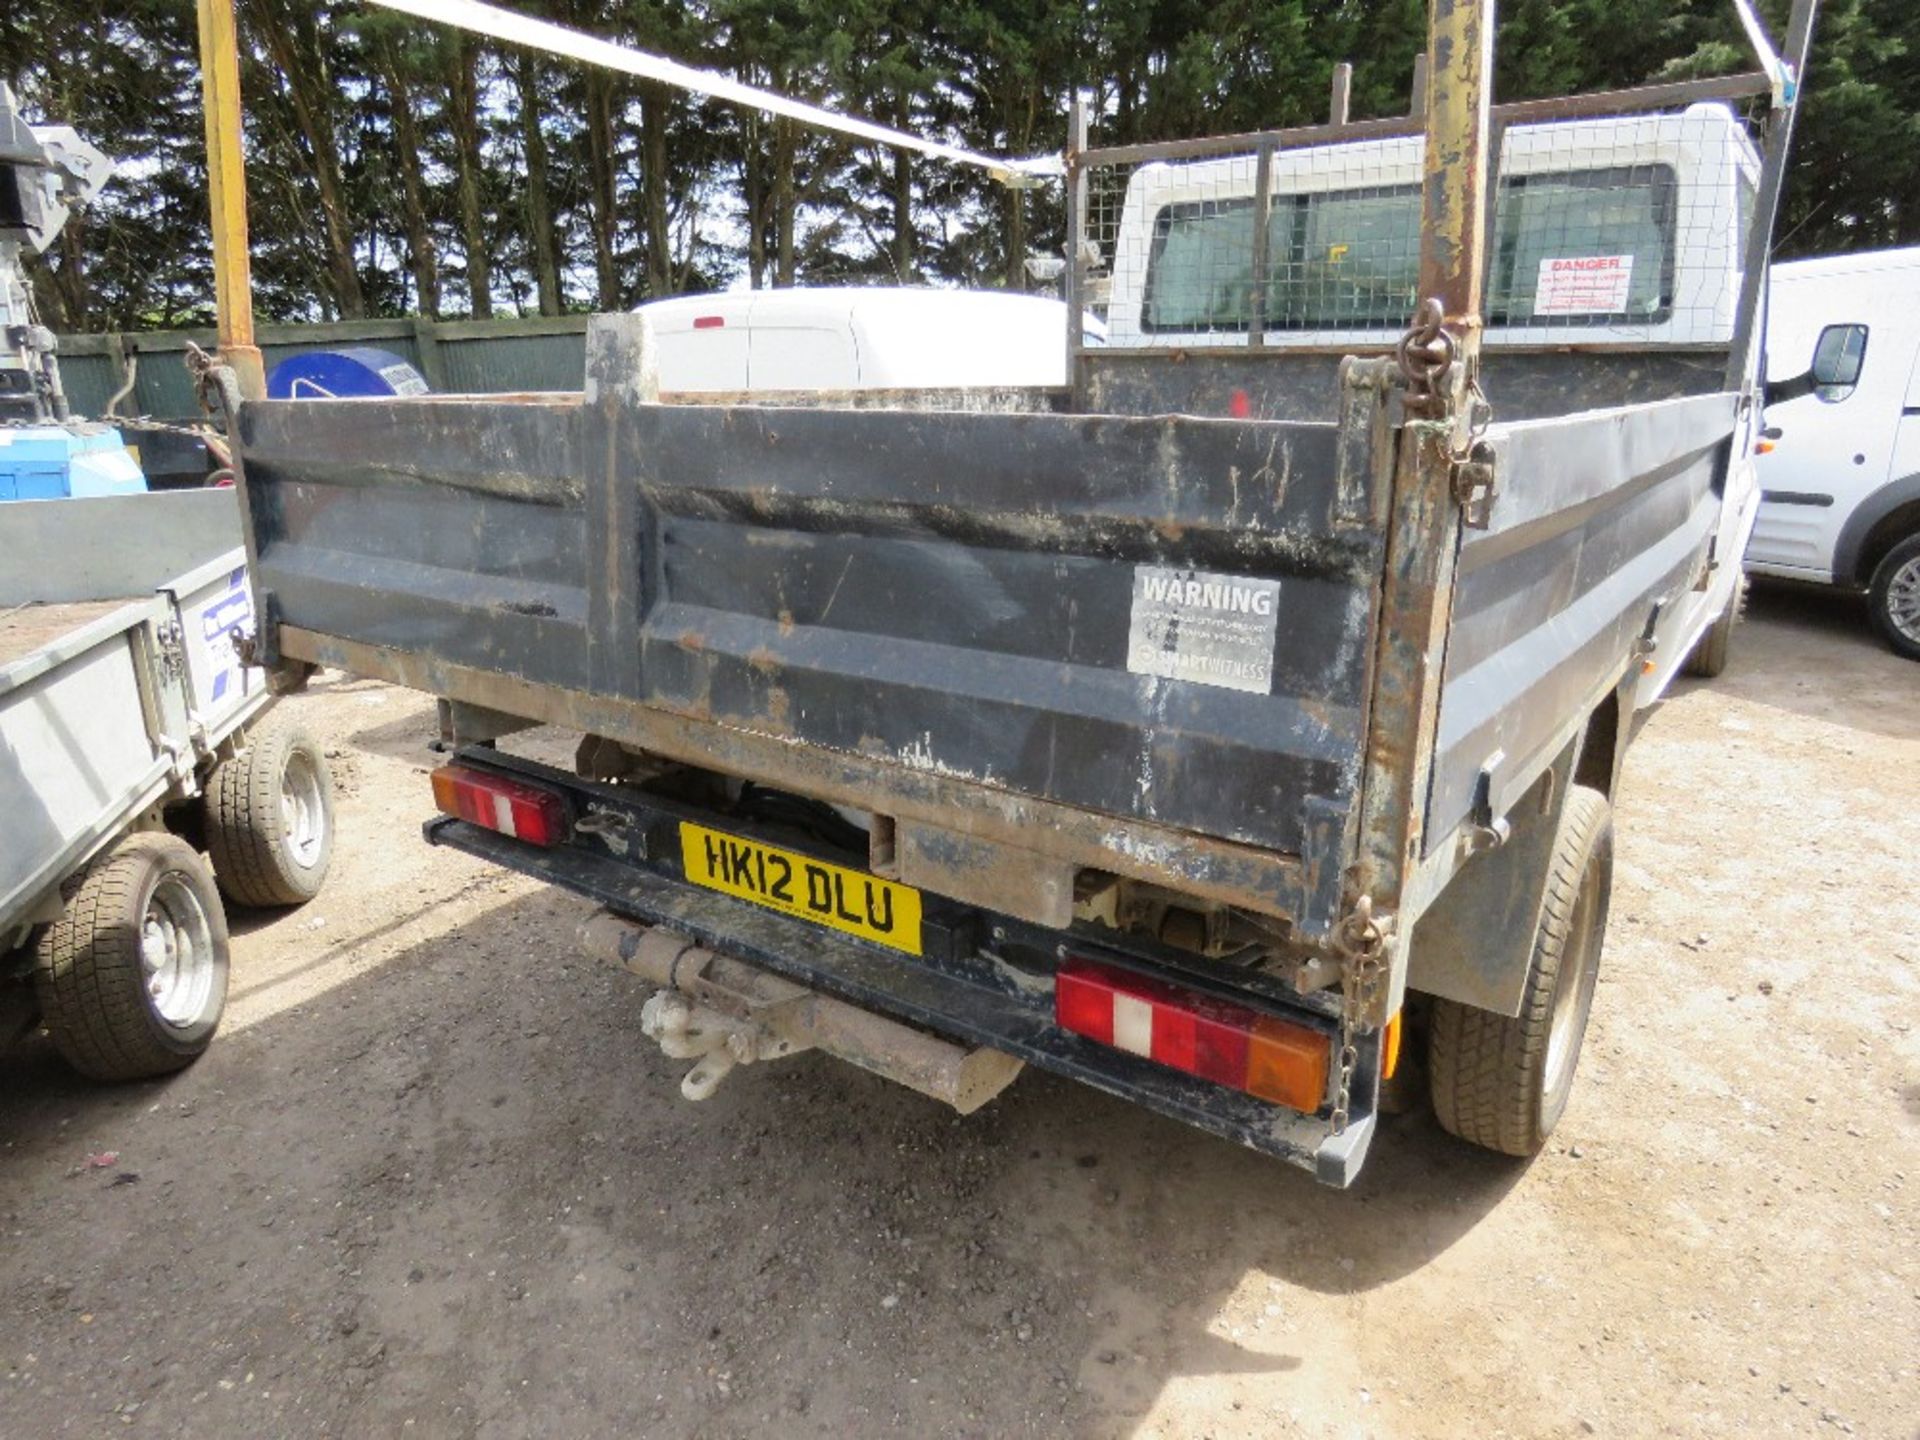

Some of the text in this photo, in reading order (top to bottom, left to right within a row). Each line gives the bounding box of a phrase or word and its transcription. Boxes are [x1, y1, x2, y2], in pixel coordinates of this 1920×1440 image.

[1551, 258, 1620, 271] DANGER
[1143, 575, 1272, 616] WARNING
[704, 834, 894, 934] HK12 DLU
